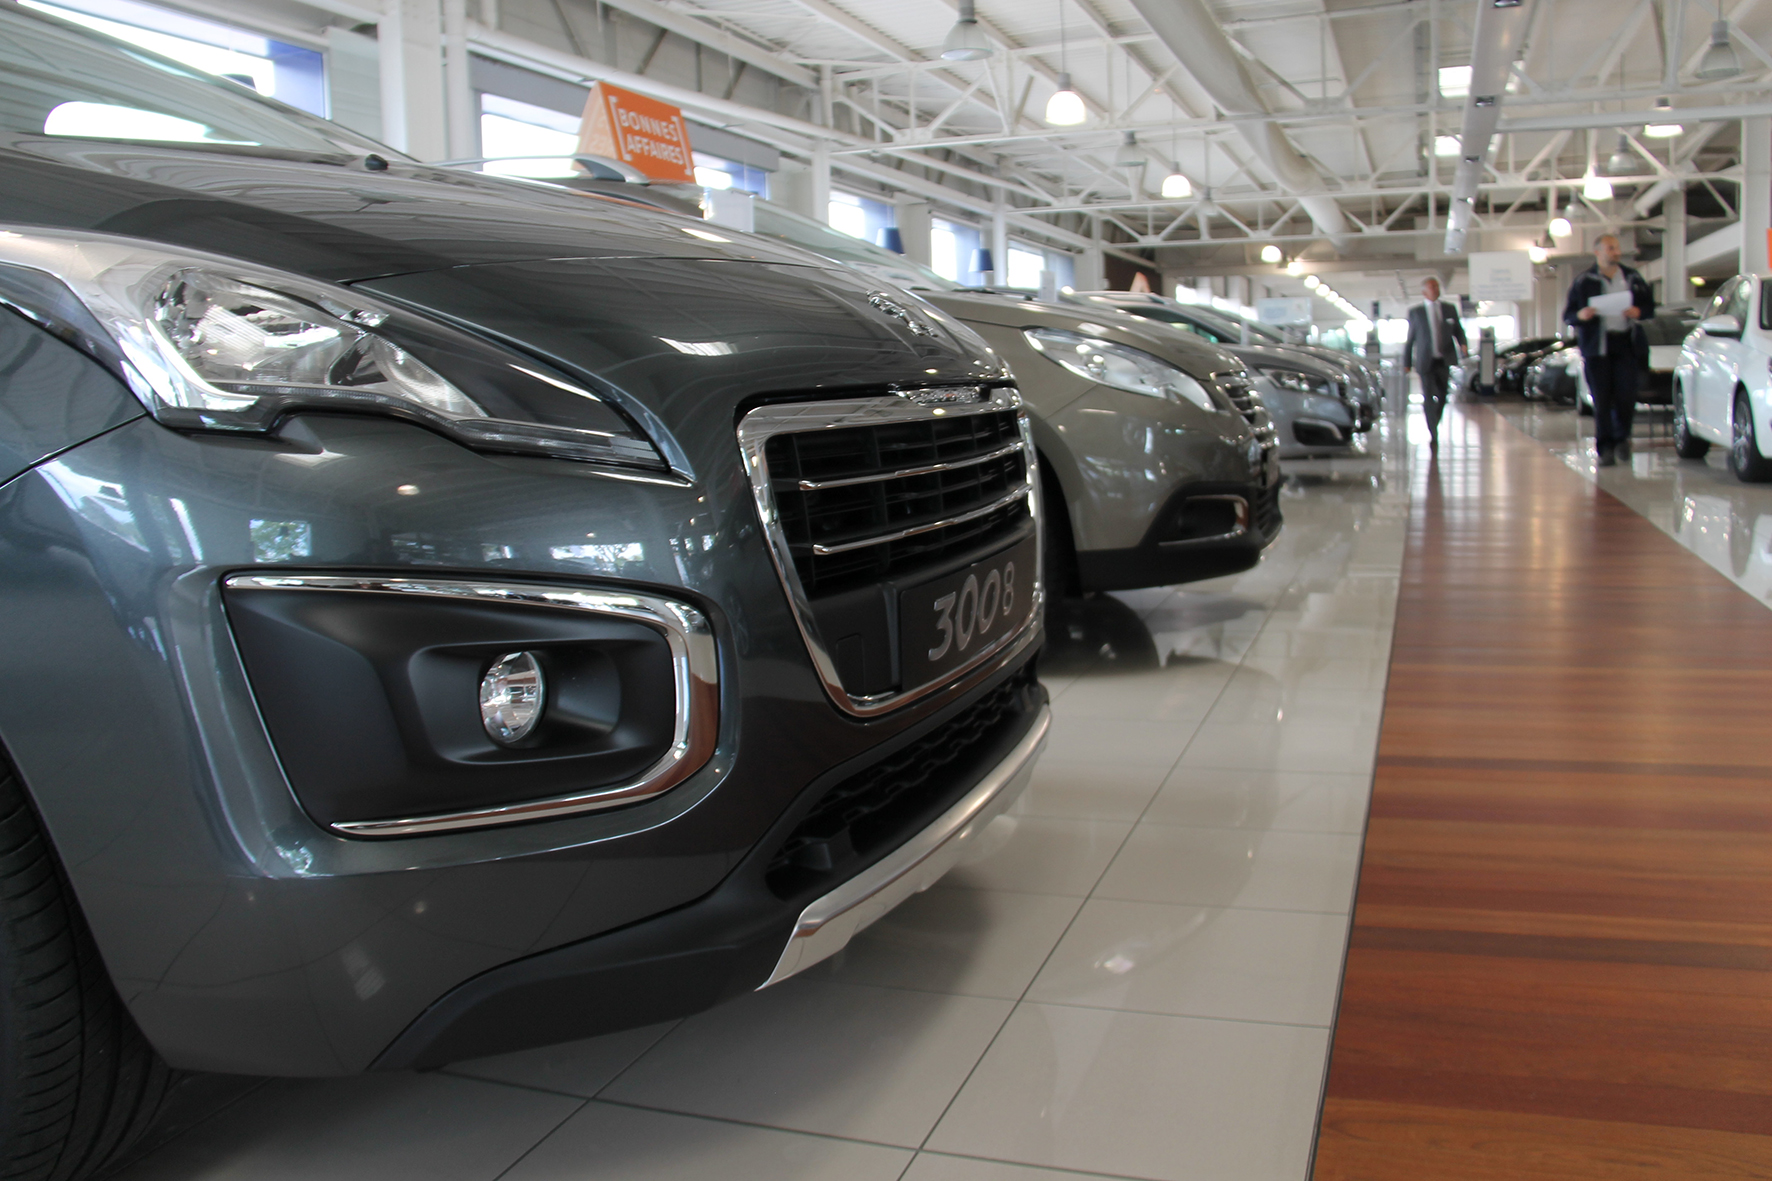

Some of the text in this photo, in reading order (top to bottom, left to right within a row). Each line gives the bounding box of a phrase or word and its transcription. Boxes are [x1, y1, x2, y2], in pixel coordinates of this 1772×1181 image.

[617, 108, 680, 141] BONNES
[626, 133, 685, 165] AFFAIRES
[928, 561, 1015, 662] 3008
